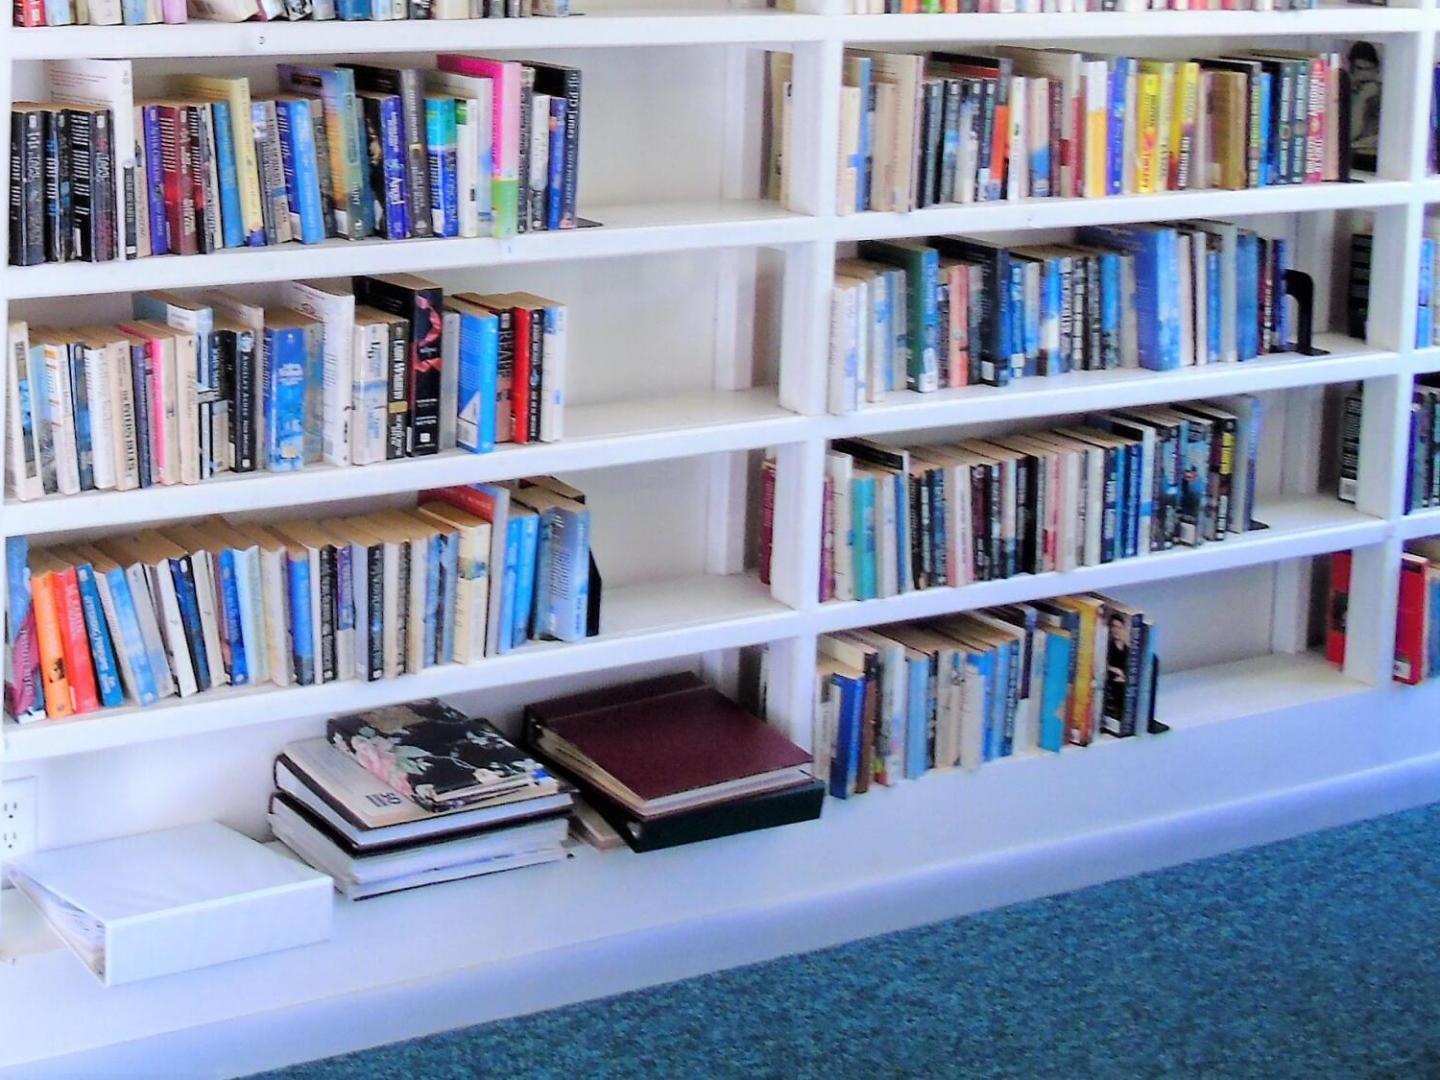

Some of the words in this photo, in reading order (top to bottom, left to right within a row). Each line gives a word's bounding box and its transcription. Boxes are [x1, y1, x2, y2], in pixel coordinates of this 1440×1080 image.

[568, 91, 579, 107] PD
[567, 110, 579, 139] James
[390, 177, 406, 205] Angel
